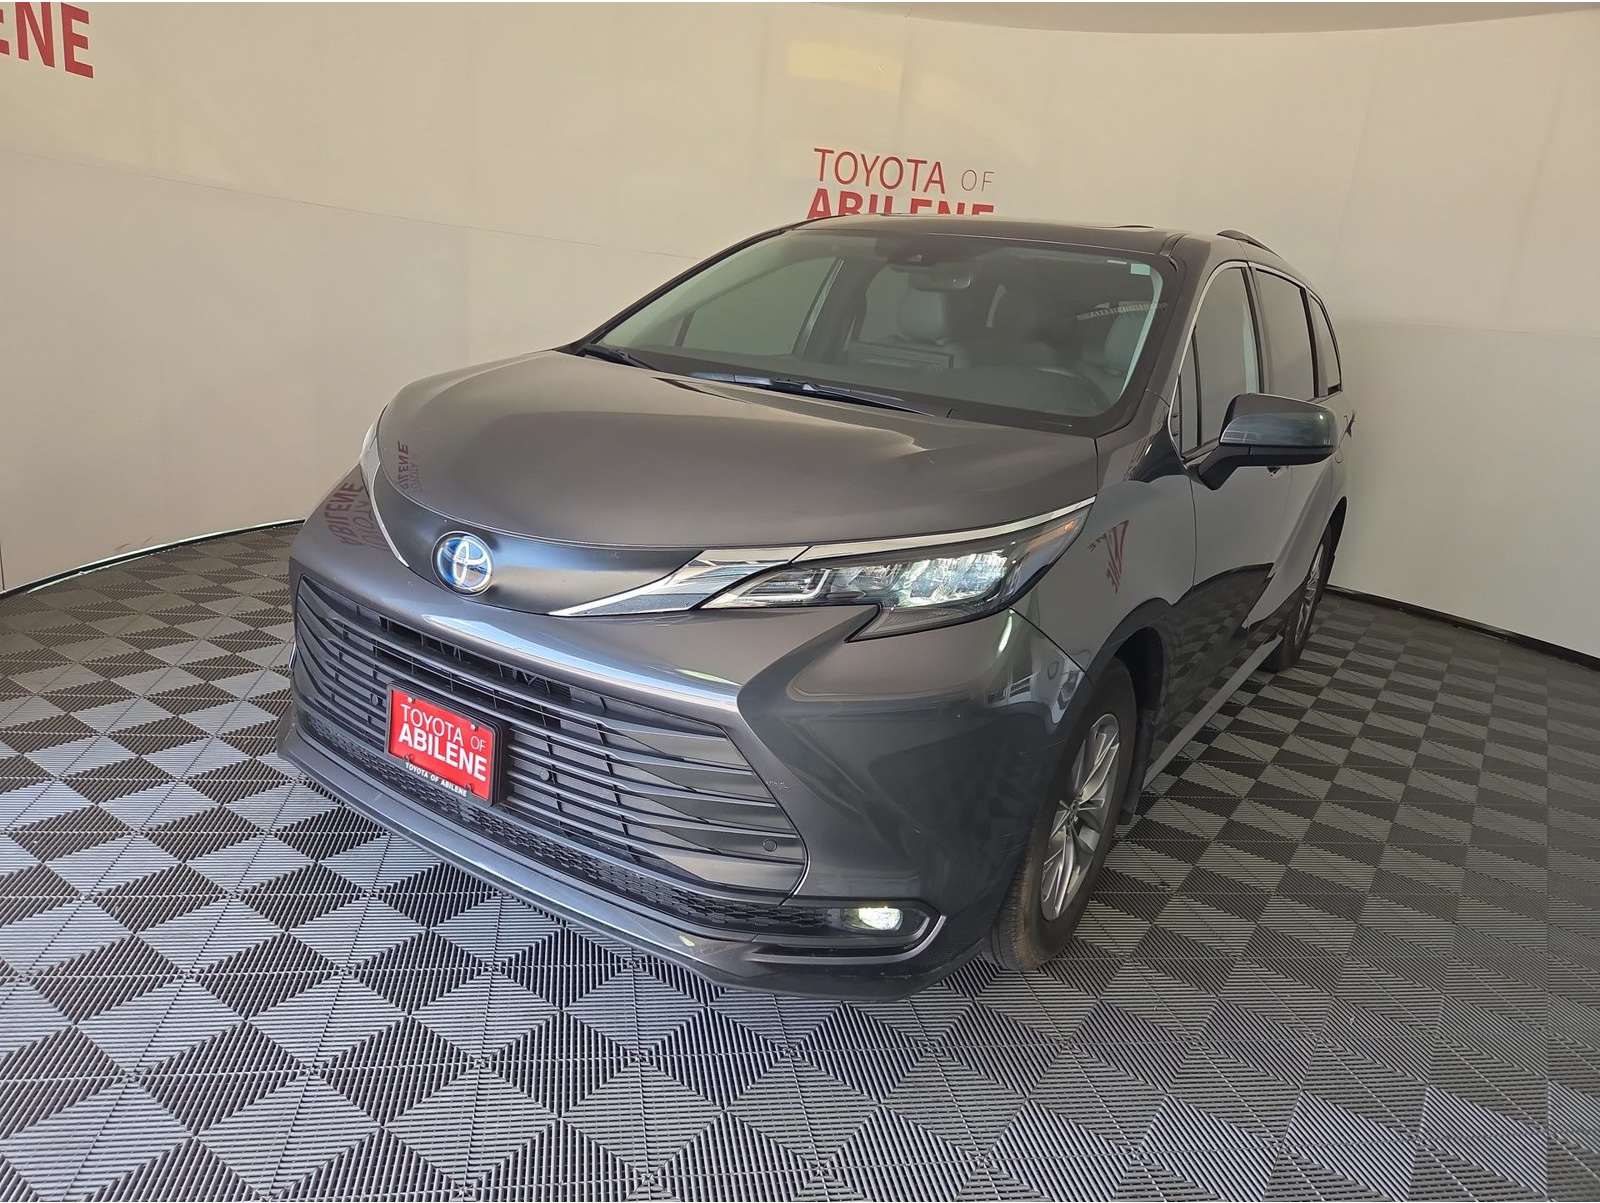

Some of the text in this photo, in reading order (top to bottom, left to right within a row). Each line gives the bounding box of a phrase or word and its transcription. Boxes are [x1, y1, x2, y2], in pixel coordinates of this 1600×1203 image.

[814, 148, 995, 194] TOYOTA OF
[806, 188, 995, 219] ABIL
[401, 704, 487, 752] TOYOTA OF
[398, 723, 488, 782] ABILENE
[405, 762, 468, 798] TOYOTA OF ABILENE
